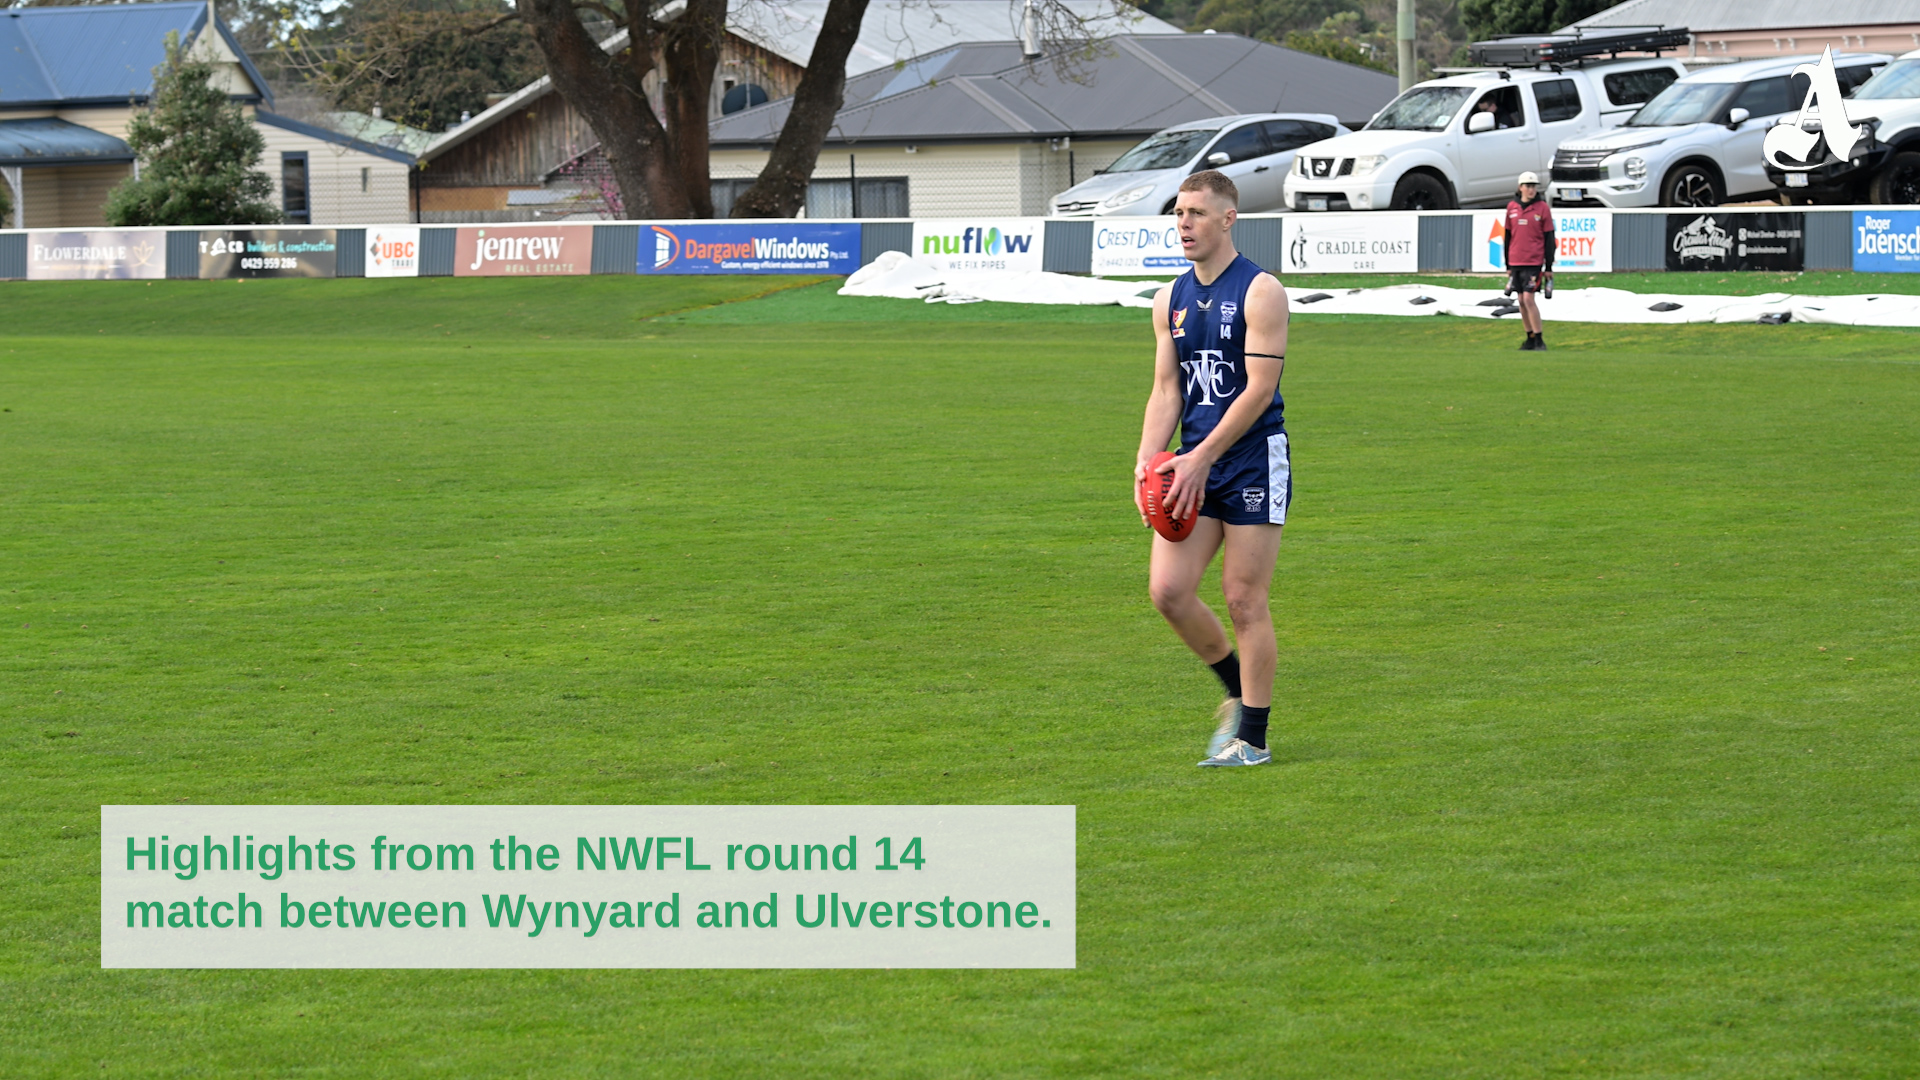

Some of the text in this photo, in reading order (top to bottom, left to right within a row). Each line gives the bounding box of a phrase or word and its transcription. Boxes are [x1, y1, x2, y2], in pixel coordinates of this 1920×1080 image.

[1561, 218, 1596, 232] BAKER
[1865, 215, 1891, 233] Roger
[923, 227, 1032, 256] nuflow
[1097, 228, 1136, 249] CREST
[1137, 228, 1163, 248] DRY
[33, 244, 127, 262] FLOWERDALE
[199, 239, 336, 254] T CB builders & construction
[382, 241, 414, 259] UBC
[470, 229, 564, 270] jenrew
[1317, 240, 1411, 254] CRADLE COAST
[241, 257, 298, 270] 0429 959 286
[505, 263, 574, 273] REAL ESTATE
[781, 261, 803, 269] windows
[803, 261, 816, 269] since
[949, 260, 1006, 269] WE FIX PIPES
[1353, 261, 1375, 269] CARE
[1220, 324, 1232, 340] 14
